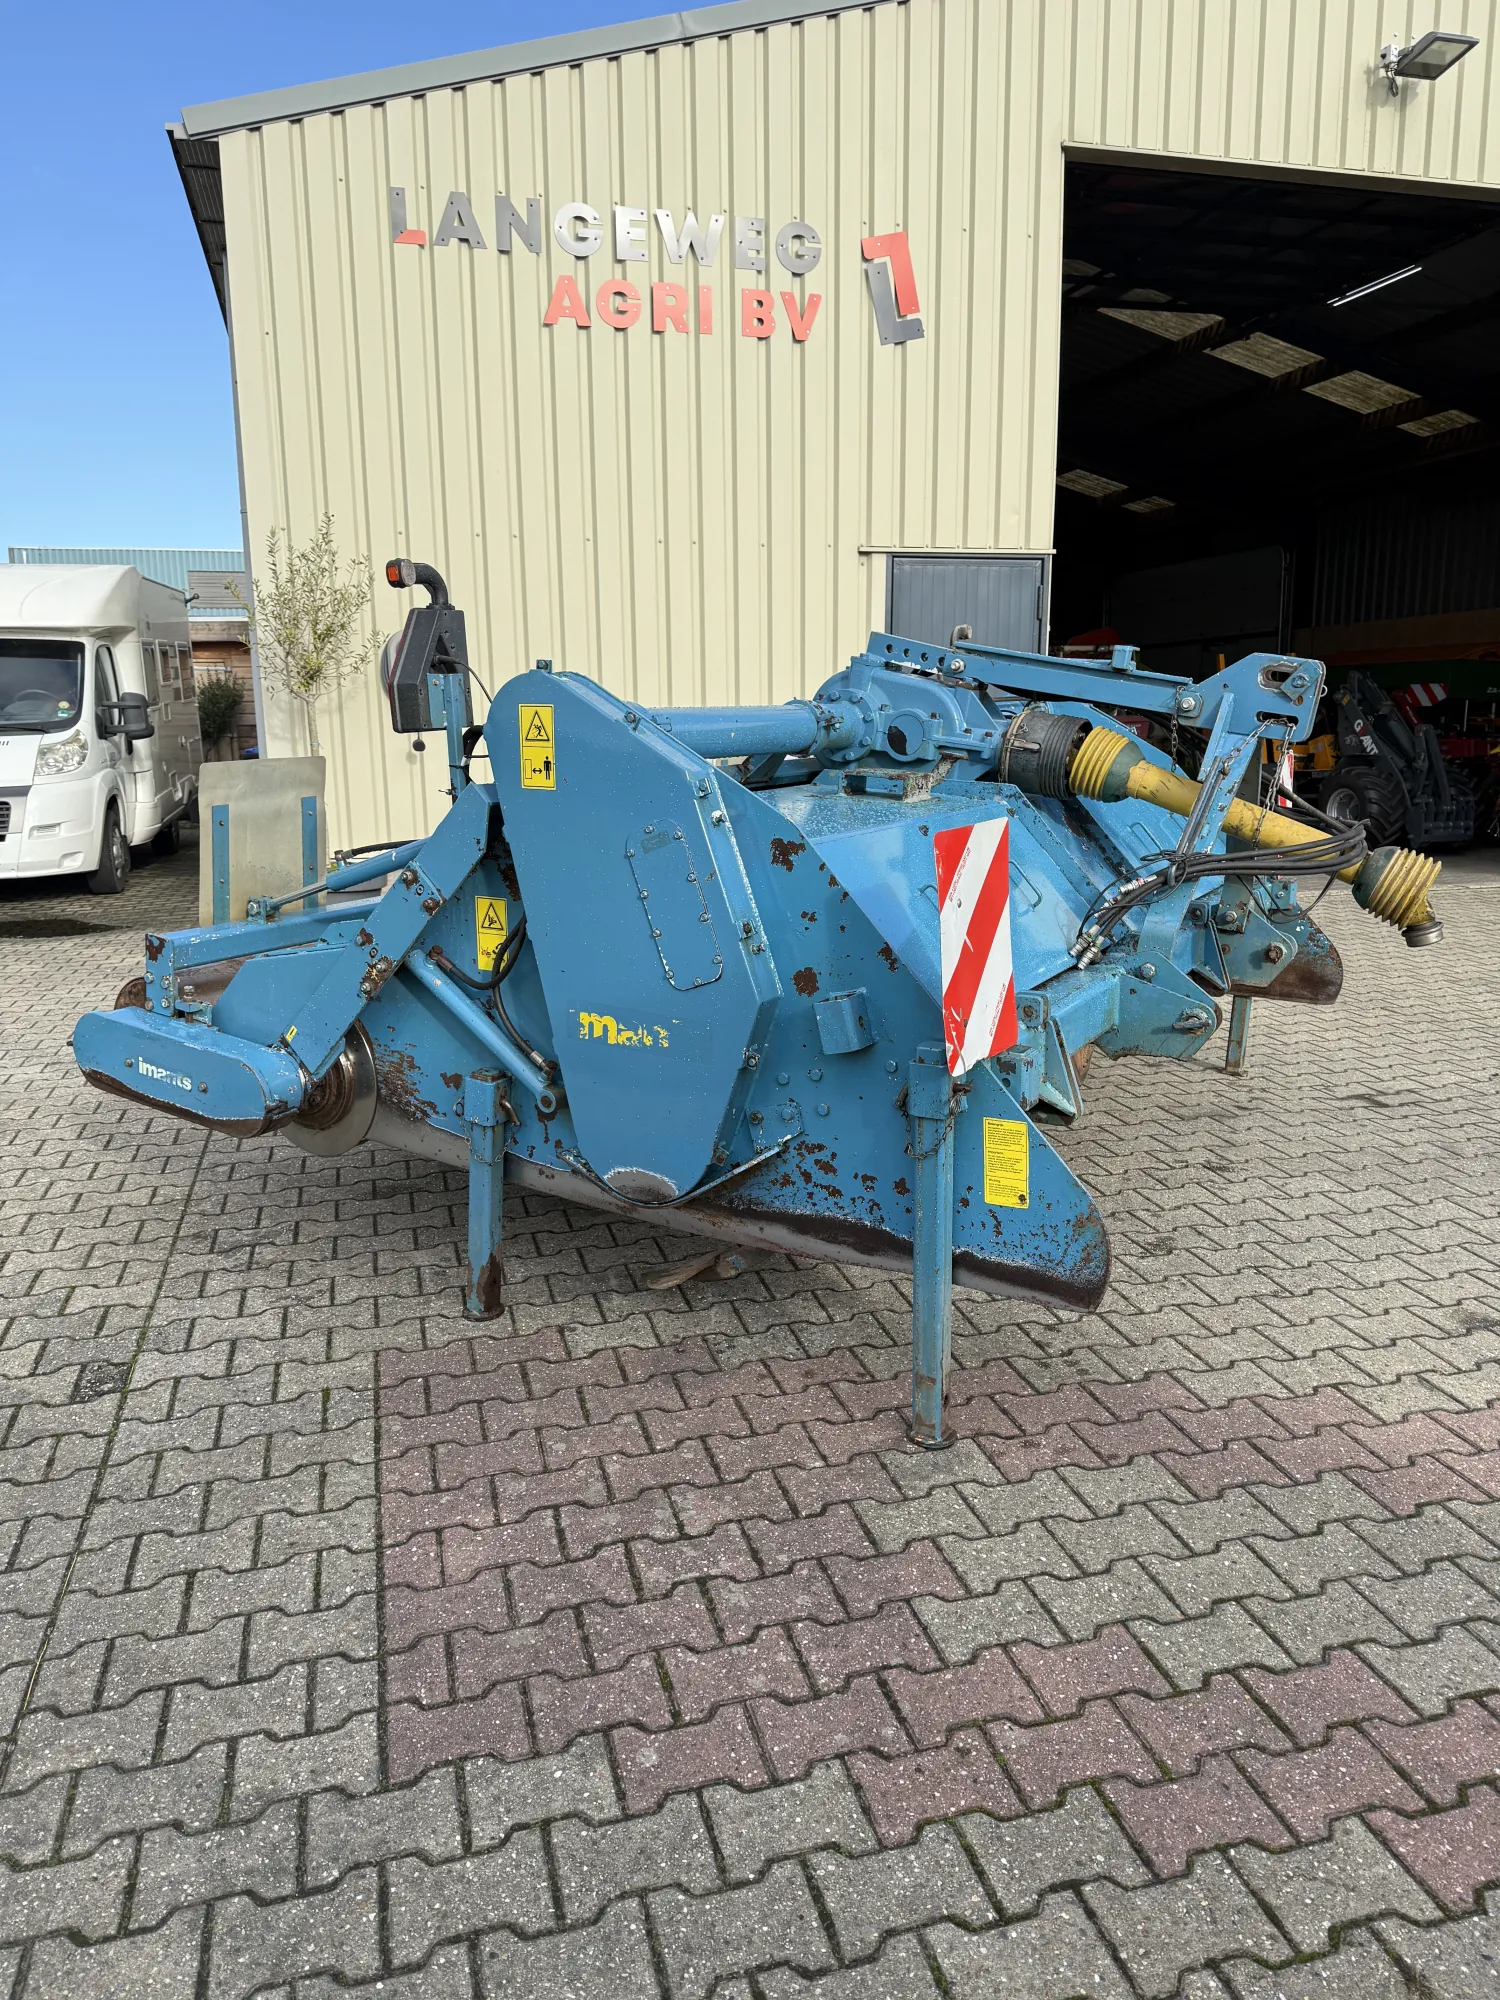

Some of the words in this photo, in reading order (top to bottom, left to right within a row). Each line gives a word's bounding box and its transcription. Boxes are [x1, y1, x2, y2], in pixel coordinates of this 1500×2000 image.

[390, 186, 822, 274] LANGEWEG
[543, 274, 713, 335] AGRI
[741, 288, 822, 341] BV
[1354, 719, 1379, 755] GIANT
[138, 1056, 192, 1091] imants
